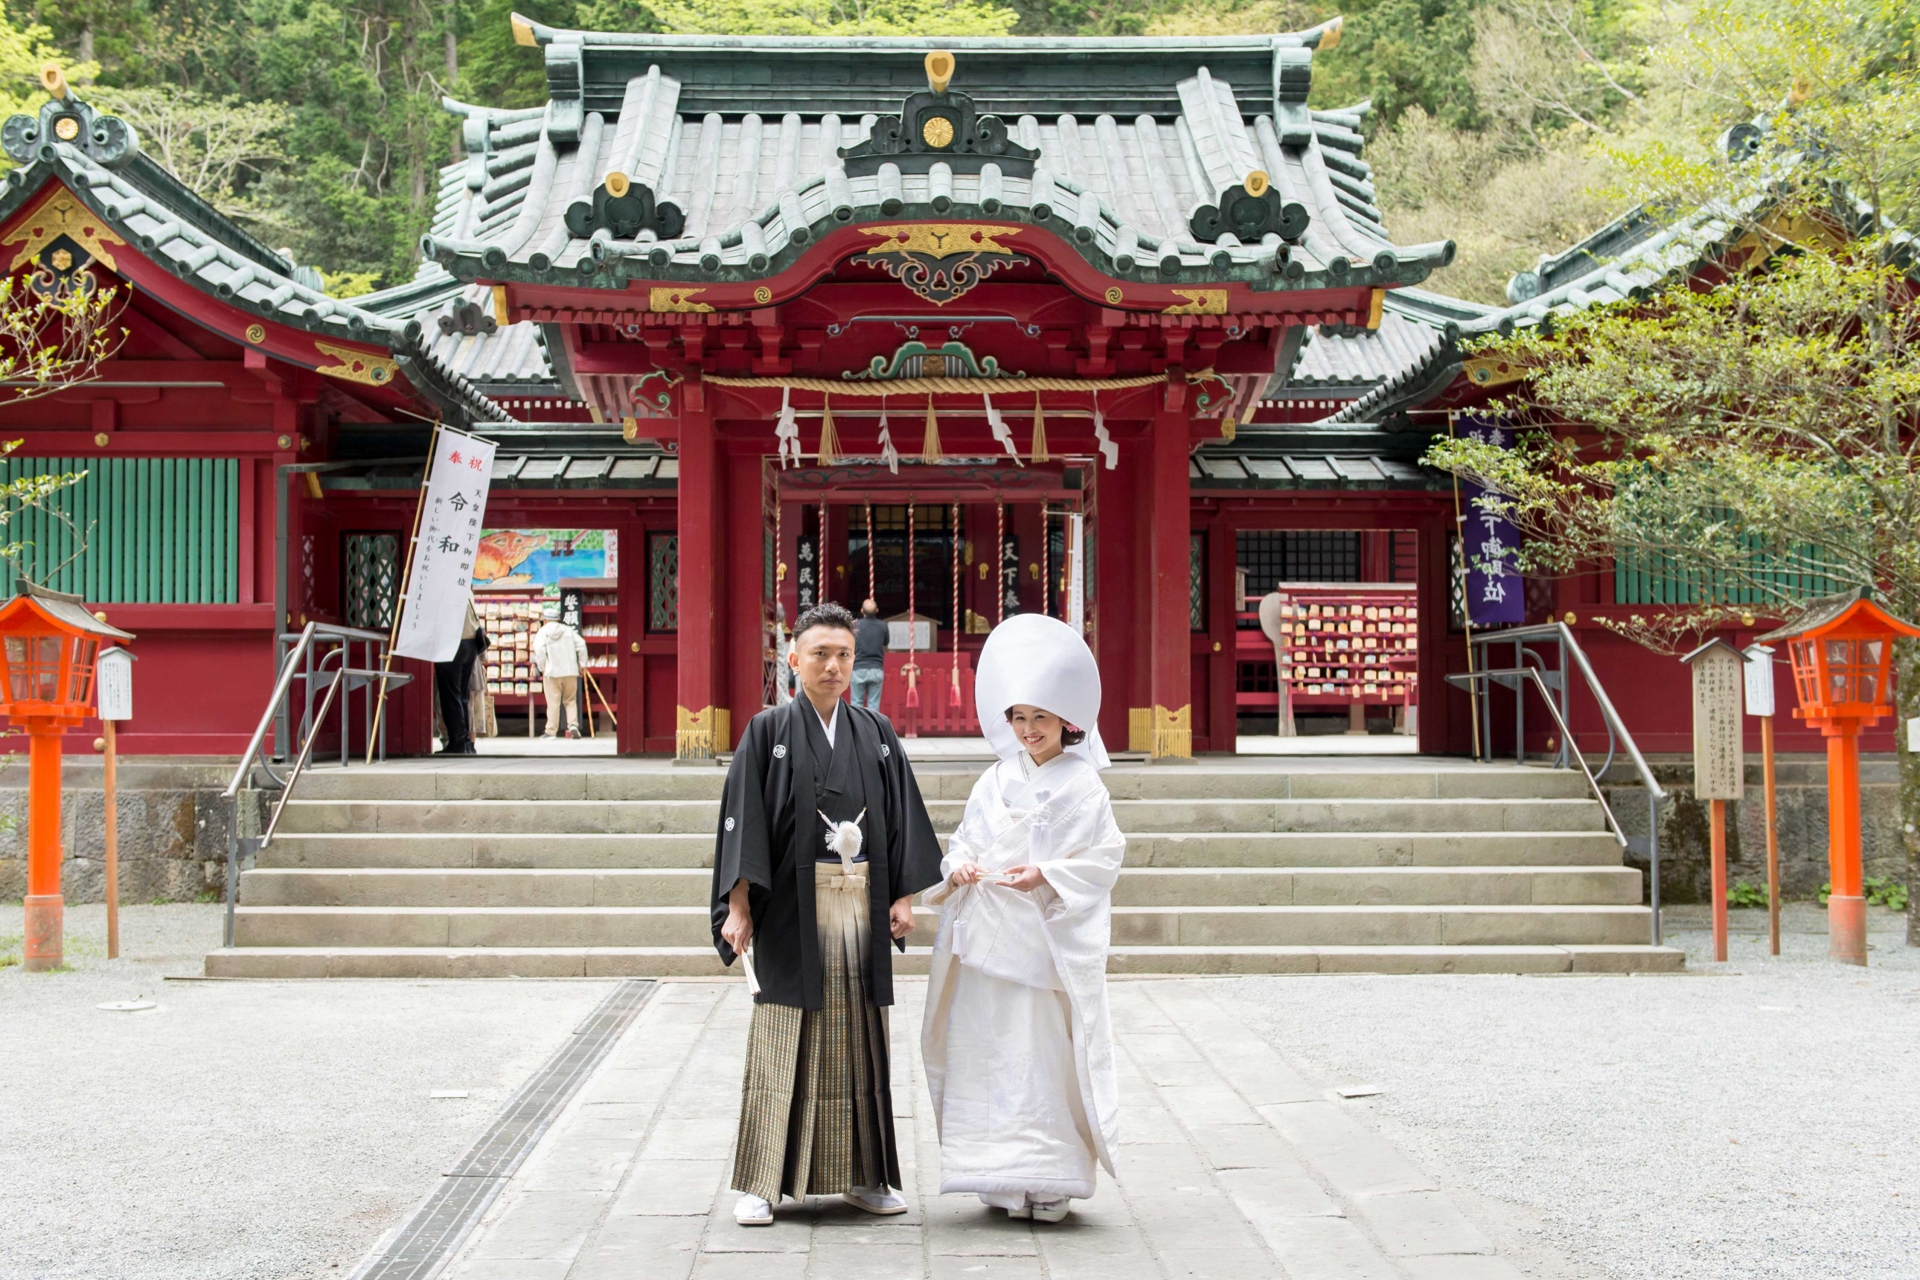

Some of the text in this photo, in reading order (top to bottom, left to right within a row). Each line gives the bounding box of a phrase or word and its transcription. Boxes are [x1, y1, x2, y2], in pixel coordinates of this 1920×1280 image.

[448, 450, 482, 472] 奉祝
[438, 491, 468, 554] 令和
[457, 489, 482, 587] 天皇陛下御即位
[1003, 542, 1020, 618] 天下泰
